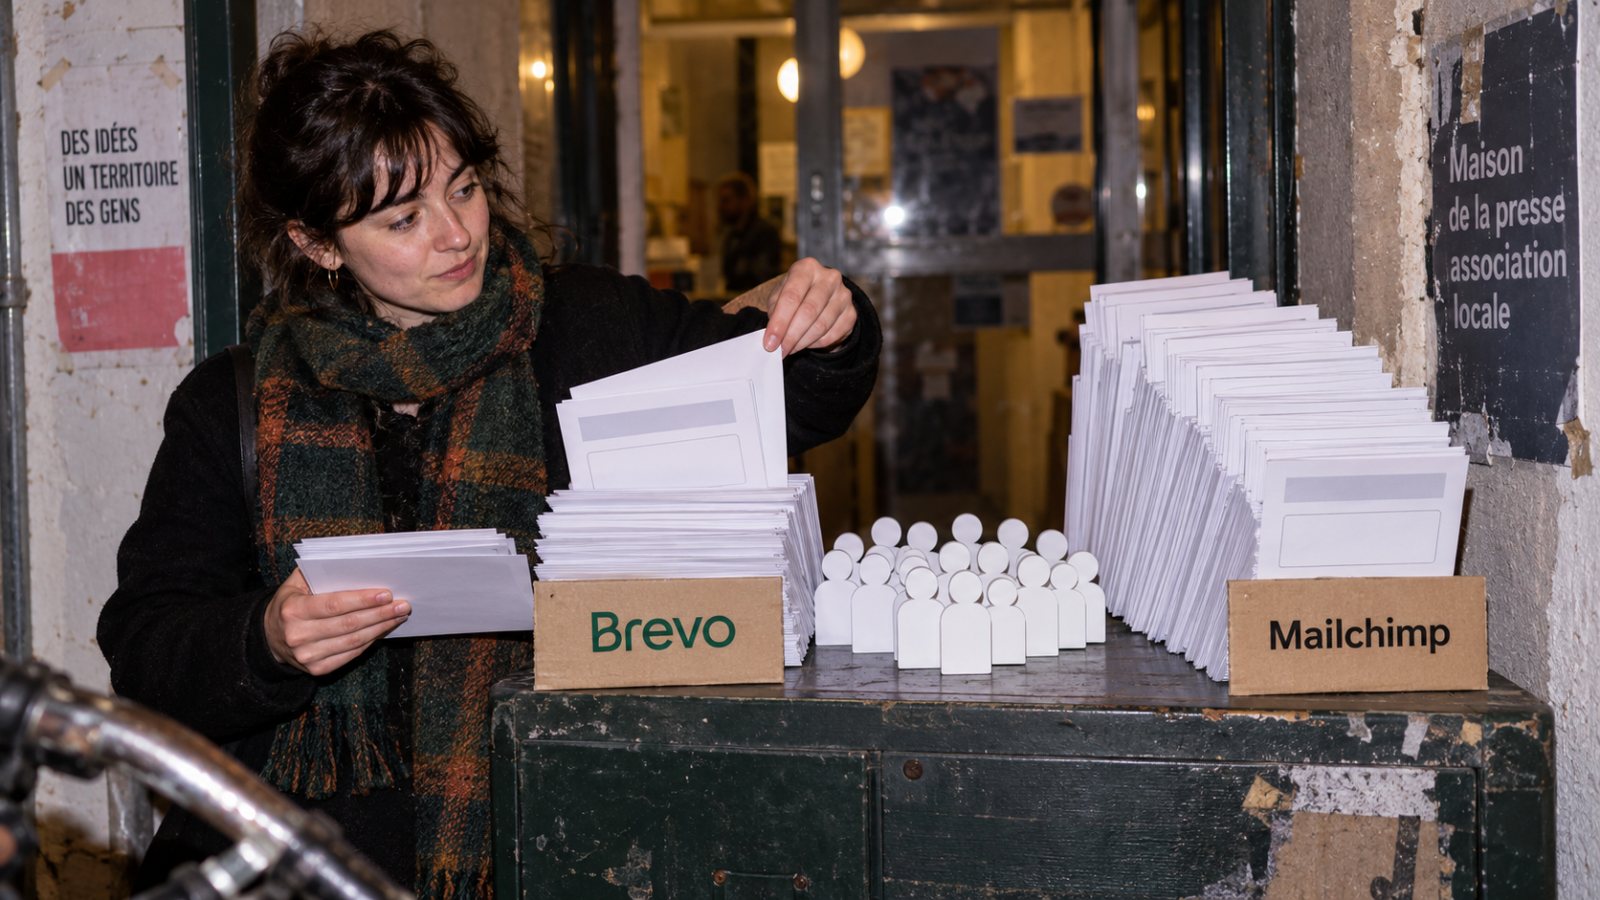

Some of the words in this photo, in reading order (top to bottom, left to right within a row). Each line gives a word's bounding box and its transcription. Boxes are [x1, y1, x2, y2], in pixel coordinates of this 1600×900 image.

[61, 129, 90, 156] DES
[95, 122, 138, 154] IDÉES
[63, 165, 86, 191] UN
[90, 160, 179, 190] TERRITOIRE
[1449, 142, 1523, 183] Maison
[66, 200, 95, 226] DES
[100, 198, 141, 225] GENS
[1449, 196, 1470, 231] de
[1475, 194, 1491, 229] la
[1496, 192, 1566, 239] presse
[1450, 241, 1567, 282] association
[1454, 292, 1511, 330] locale
[591, 611, 736, 653] Brevo
[1270, 617, 1451, 654] Mailchimp
